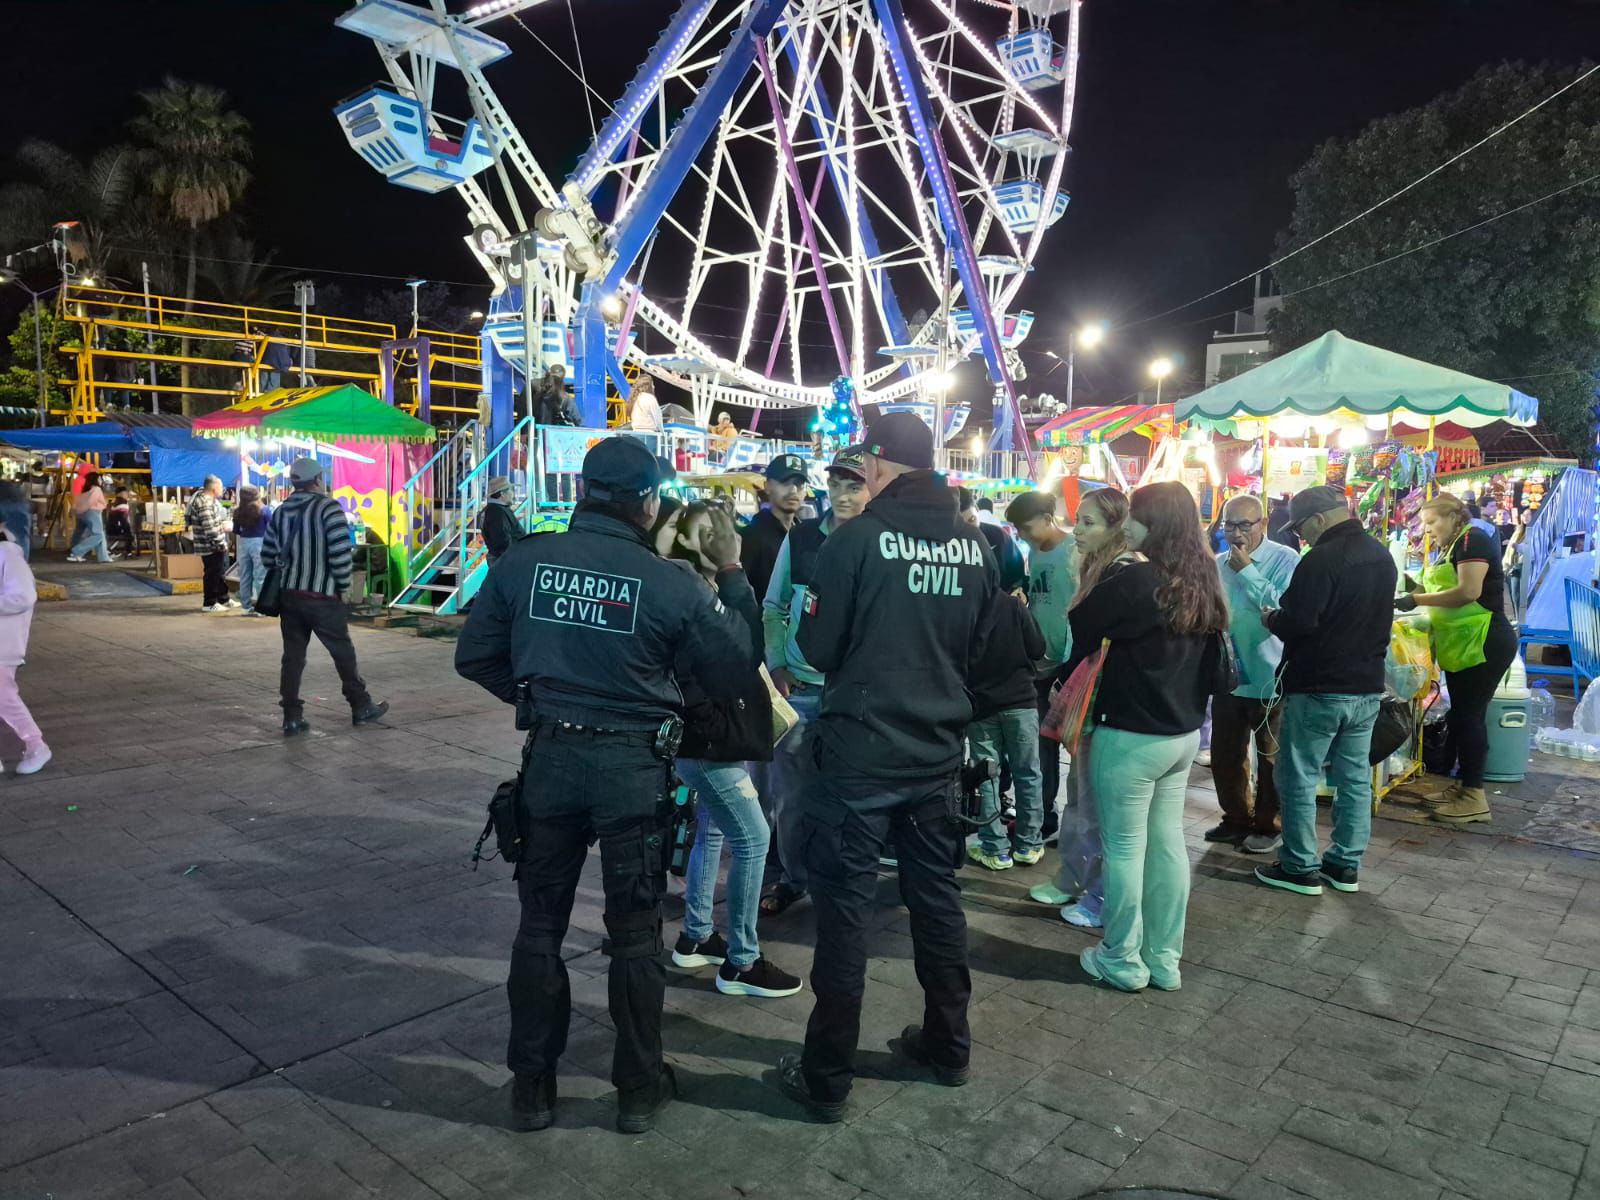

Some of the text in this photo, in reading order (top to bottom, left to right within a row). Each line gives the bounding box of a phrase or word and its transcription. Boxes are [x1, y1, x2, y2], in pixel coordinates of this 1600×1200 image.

[880, 531, 983, 567] GUARDIA
[540, 570, 630, 603] GUARDIA
[908, 563, 963, 596] CIVIL
[554, 597, 607, 625] CIVIL
